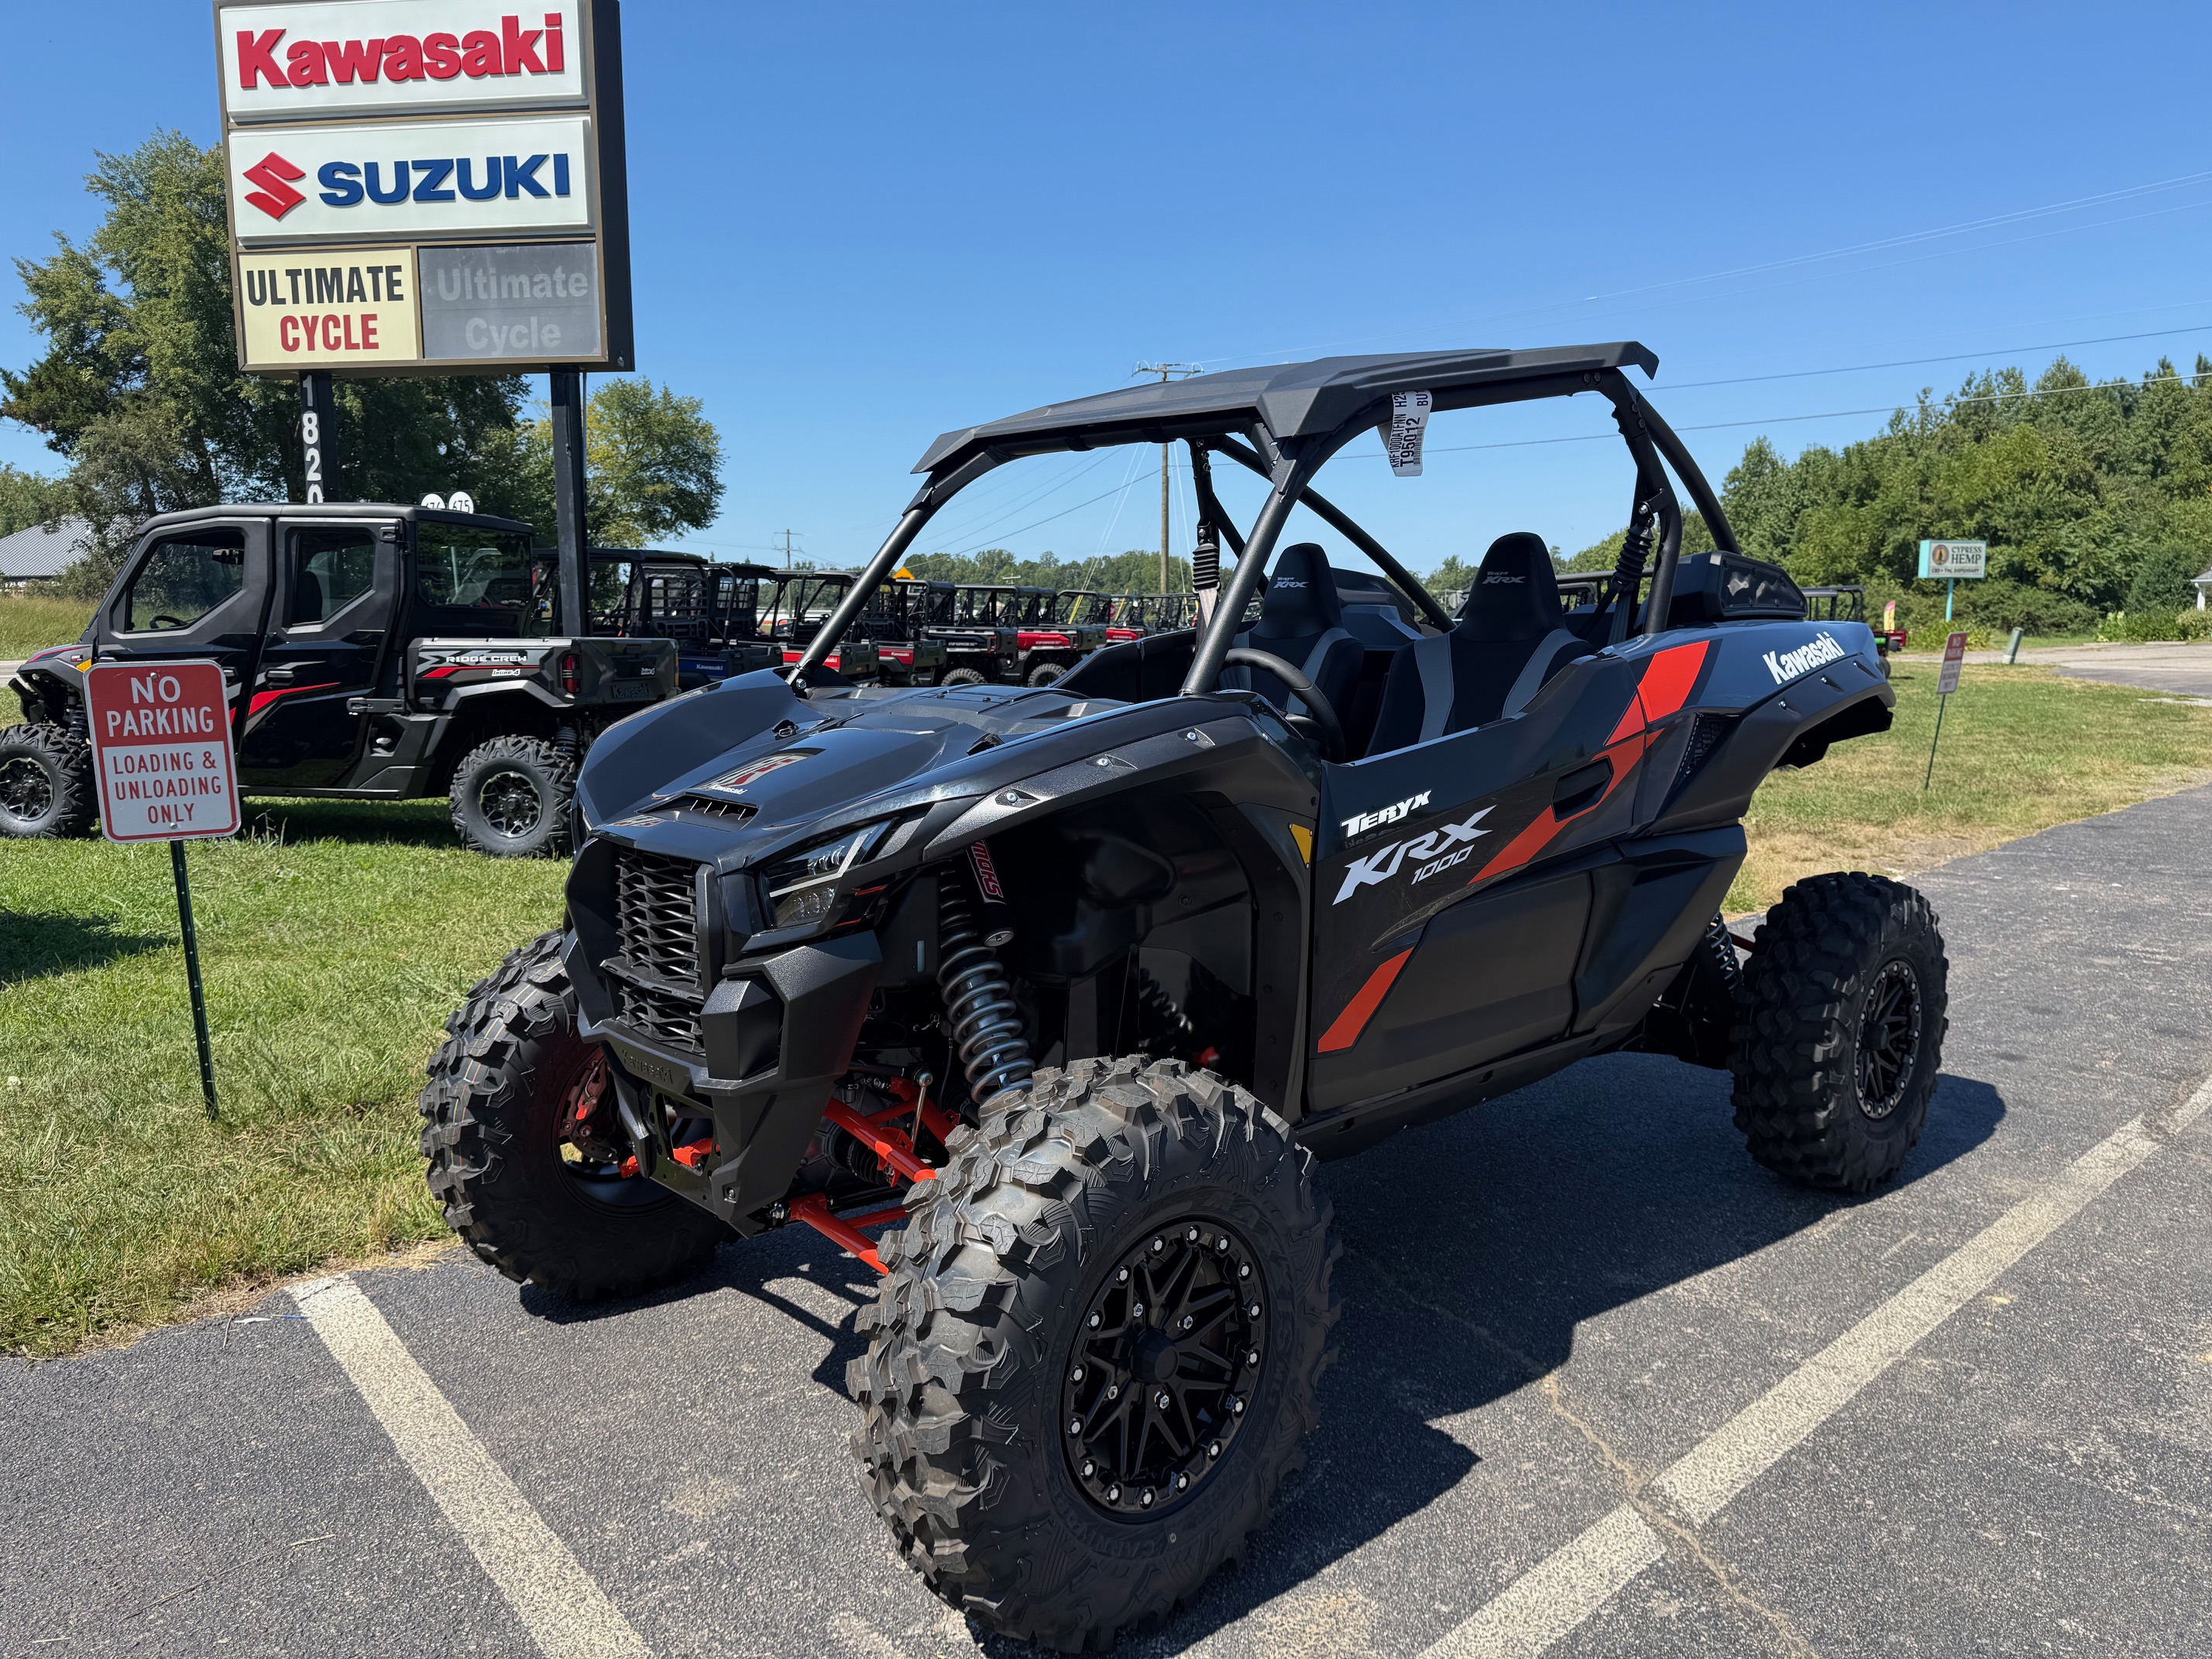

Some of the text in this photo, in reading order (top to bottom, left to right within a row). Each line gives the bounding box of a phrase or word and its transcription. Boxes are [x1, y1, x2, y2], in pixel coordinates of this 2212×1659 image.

[236, 12, 564, 88] Kawasaki
[318, 153, 569, 206] SUZUKI
[246, 265, 404, 306] ULTIMATE
[438, 265, 588, 301] Ultimate
[280, 314, 380, 352] CYCLE
[465, 316, 562, 356] Cycle
[1400, 417, 1420, 467] T95012
[1951, 545, 1982, 554] CYPRESS
[1951, 554, 1982, 565] HEMP
[1482, 575, 1526, 585] KRX
[1762, 631, 1846, 685] Kawasaki
[131, 675, 181, 704] NO
[106, 706, 214, 737] PARKING
[113, 750, 217, 775] LOADING &
[115, 776, 222, 800] UNLOADING
[708, 784, 748, 795] Kawasaki
[147, 803, 194, 824] ONLY
[971, 840, 1004, 898] SHOW
[1331, 804, 1497, 906] KRX
[1411, 844, 1475, 885] 1000
[621, 1049, 673, 1084] Kawasaki
